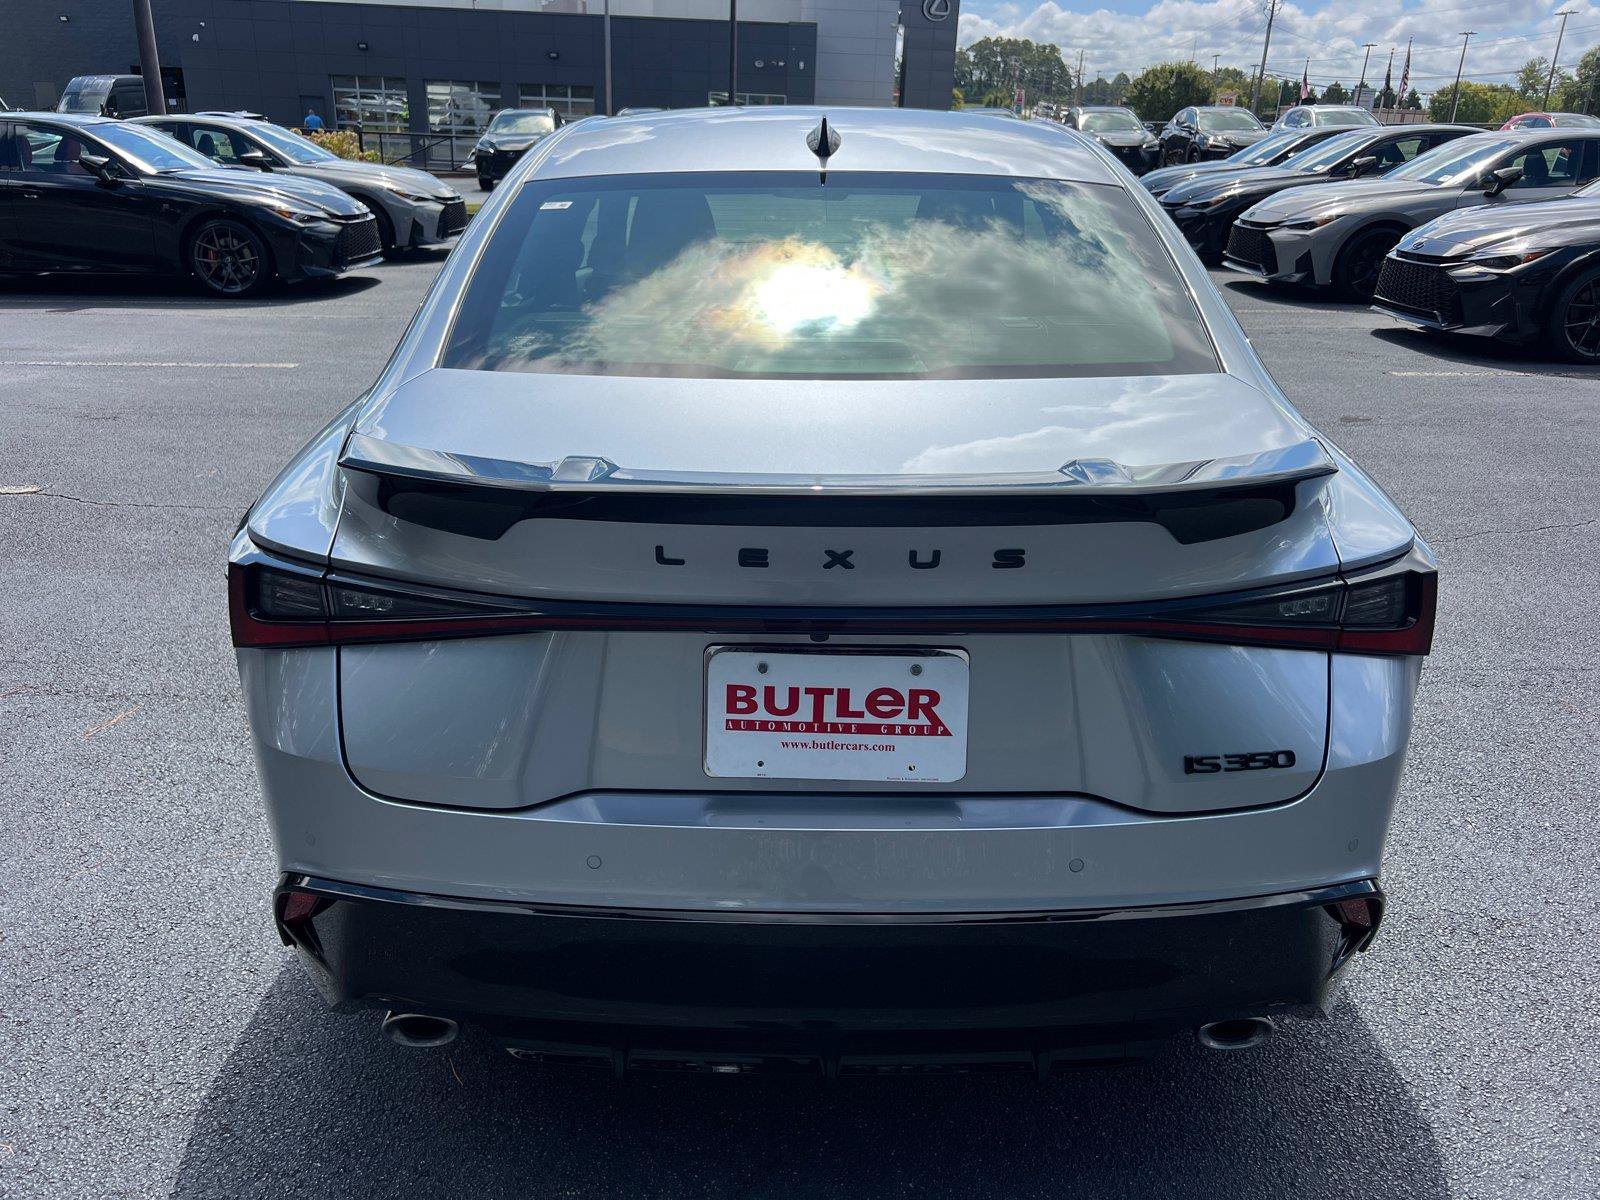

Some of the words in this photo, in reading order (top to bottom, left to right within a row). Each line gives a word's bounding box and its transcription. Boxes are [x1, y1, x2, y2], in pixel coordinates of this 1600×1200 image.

[655, 545, 1026, 570] LEXUS
[727, 720, 858, 733] AUTOMOTIVE
[881, 725, 945, 735] GROUP
[781, 740, 896, 752] www.butlercars.com
